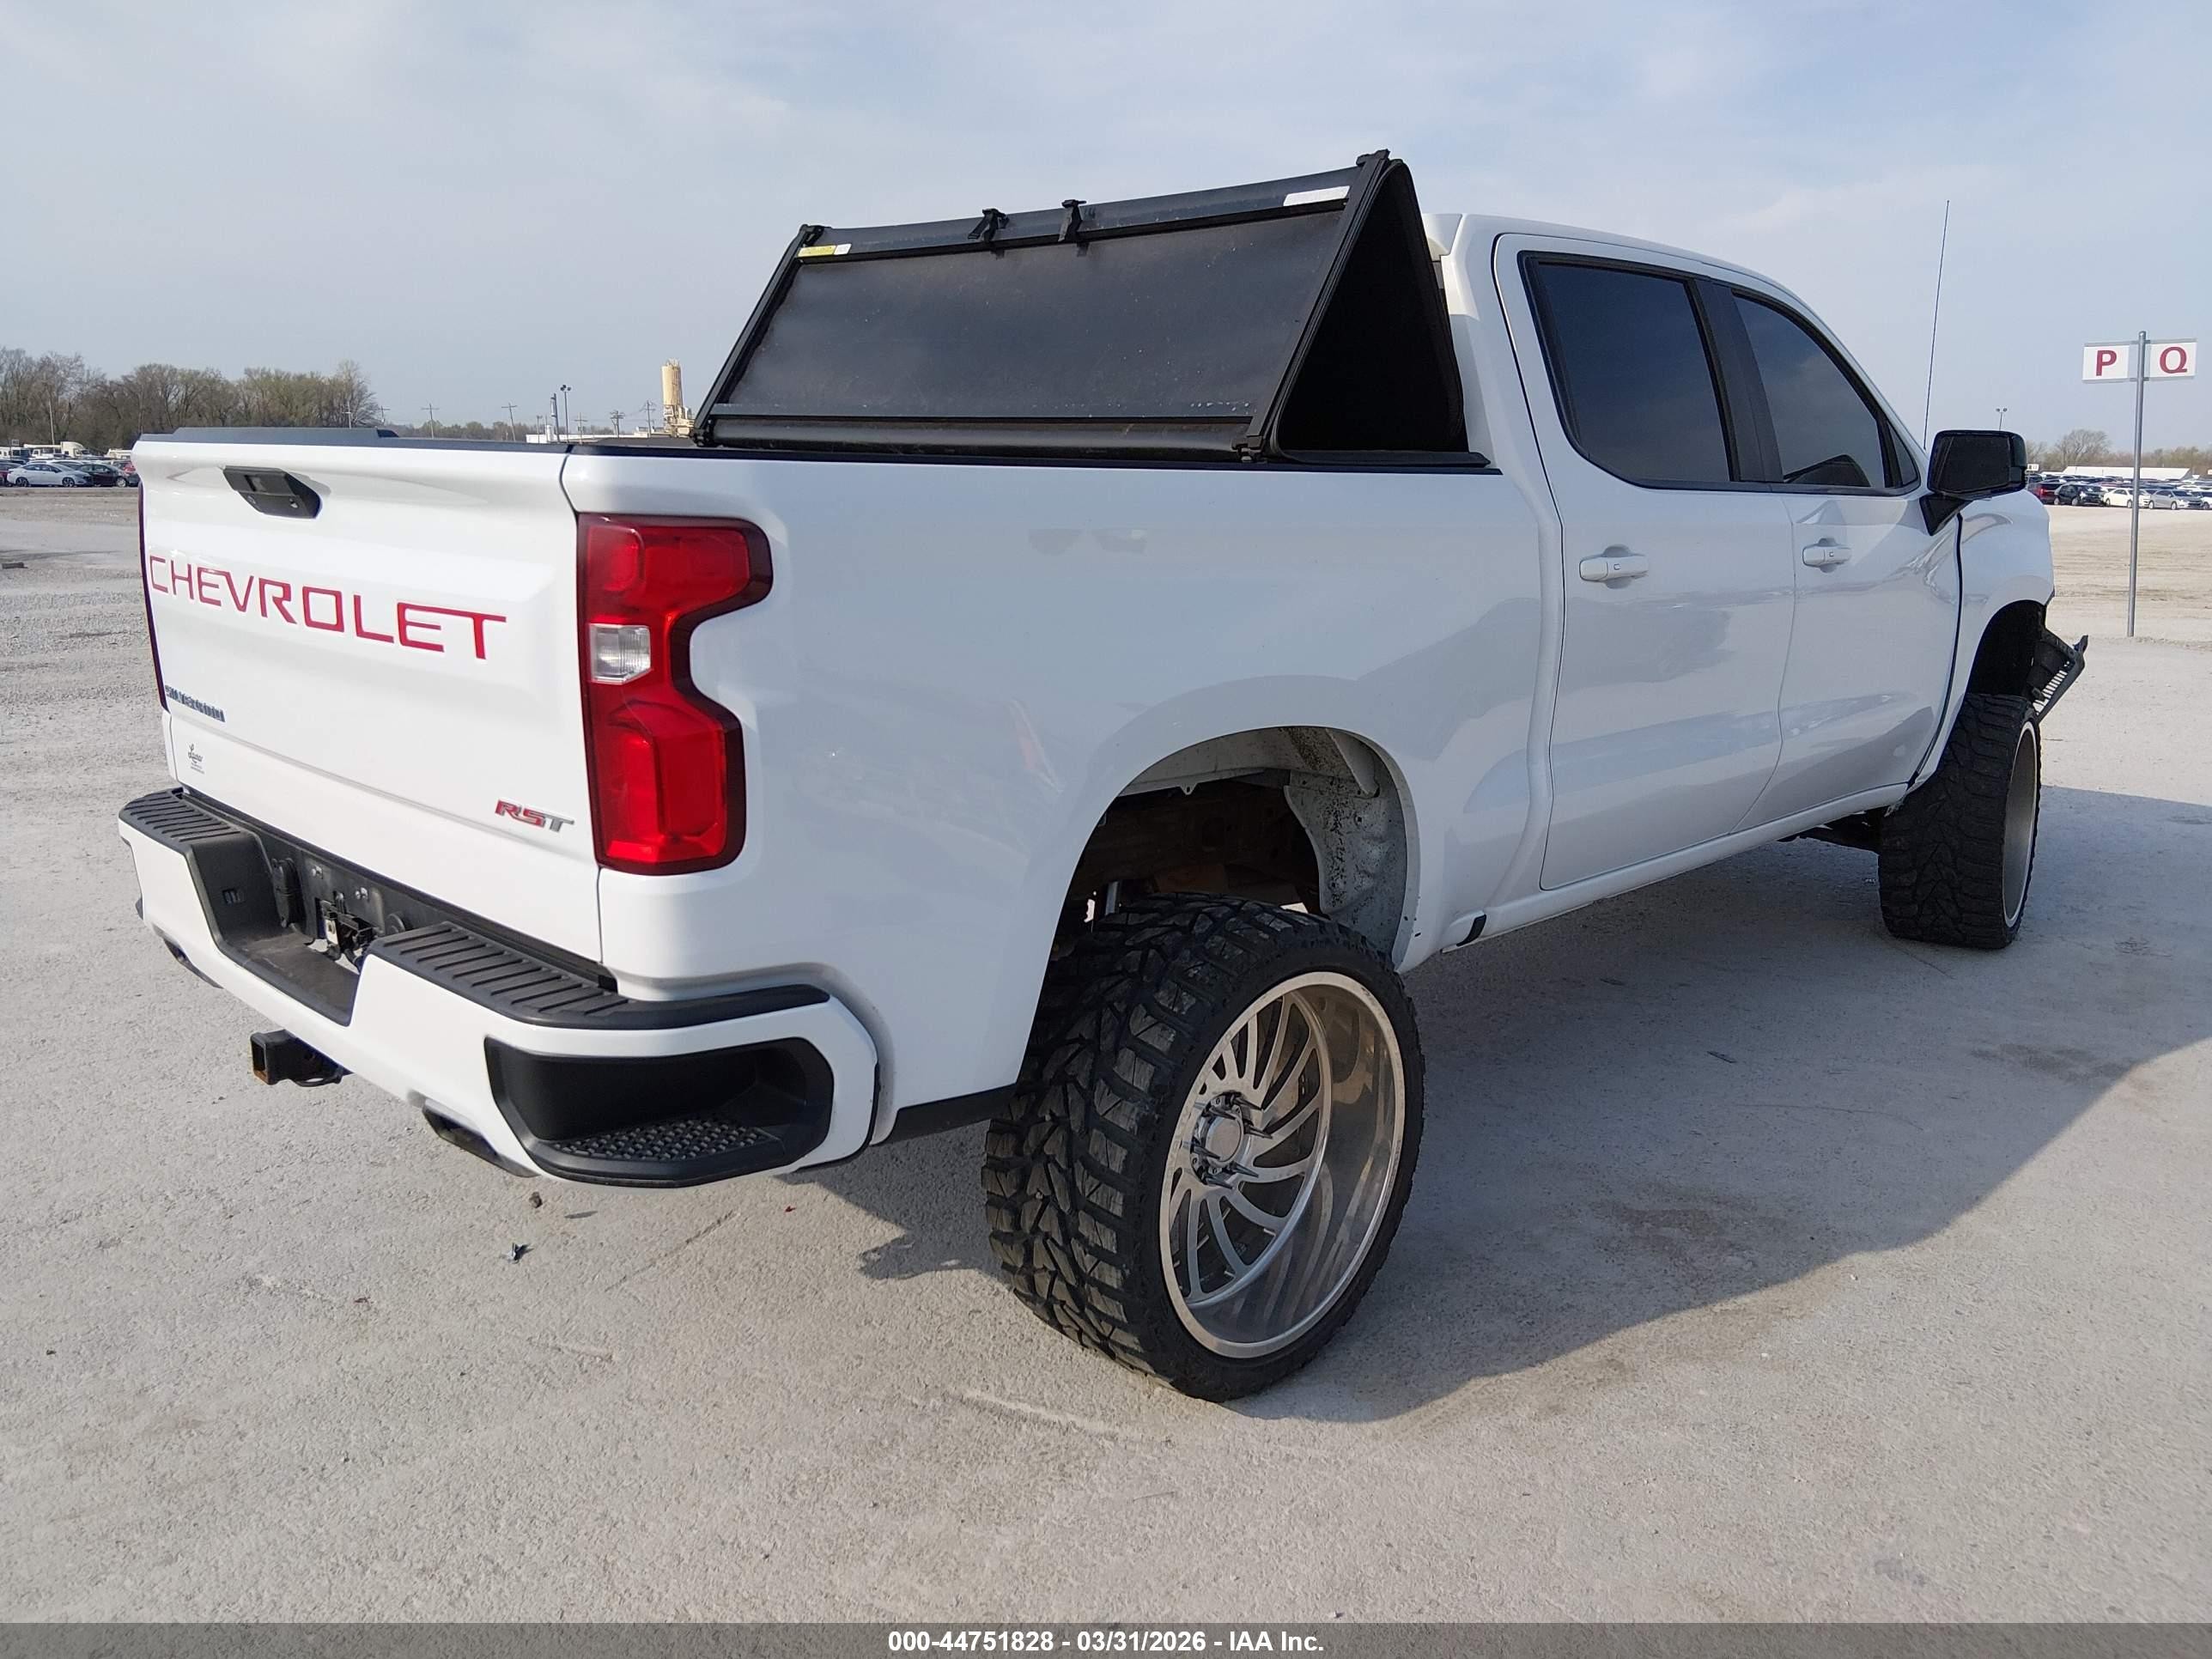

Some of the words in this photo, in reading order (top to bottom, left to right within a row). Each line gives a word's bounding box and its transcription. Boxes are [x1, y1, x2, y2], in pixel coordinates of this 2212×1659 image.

[2096, 350, 2117, 376] P
[2160, 347, 2187, 374] Q
[149, 556, 507, 659] CHEVROLET
[495, 799, 574, 833] RST
